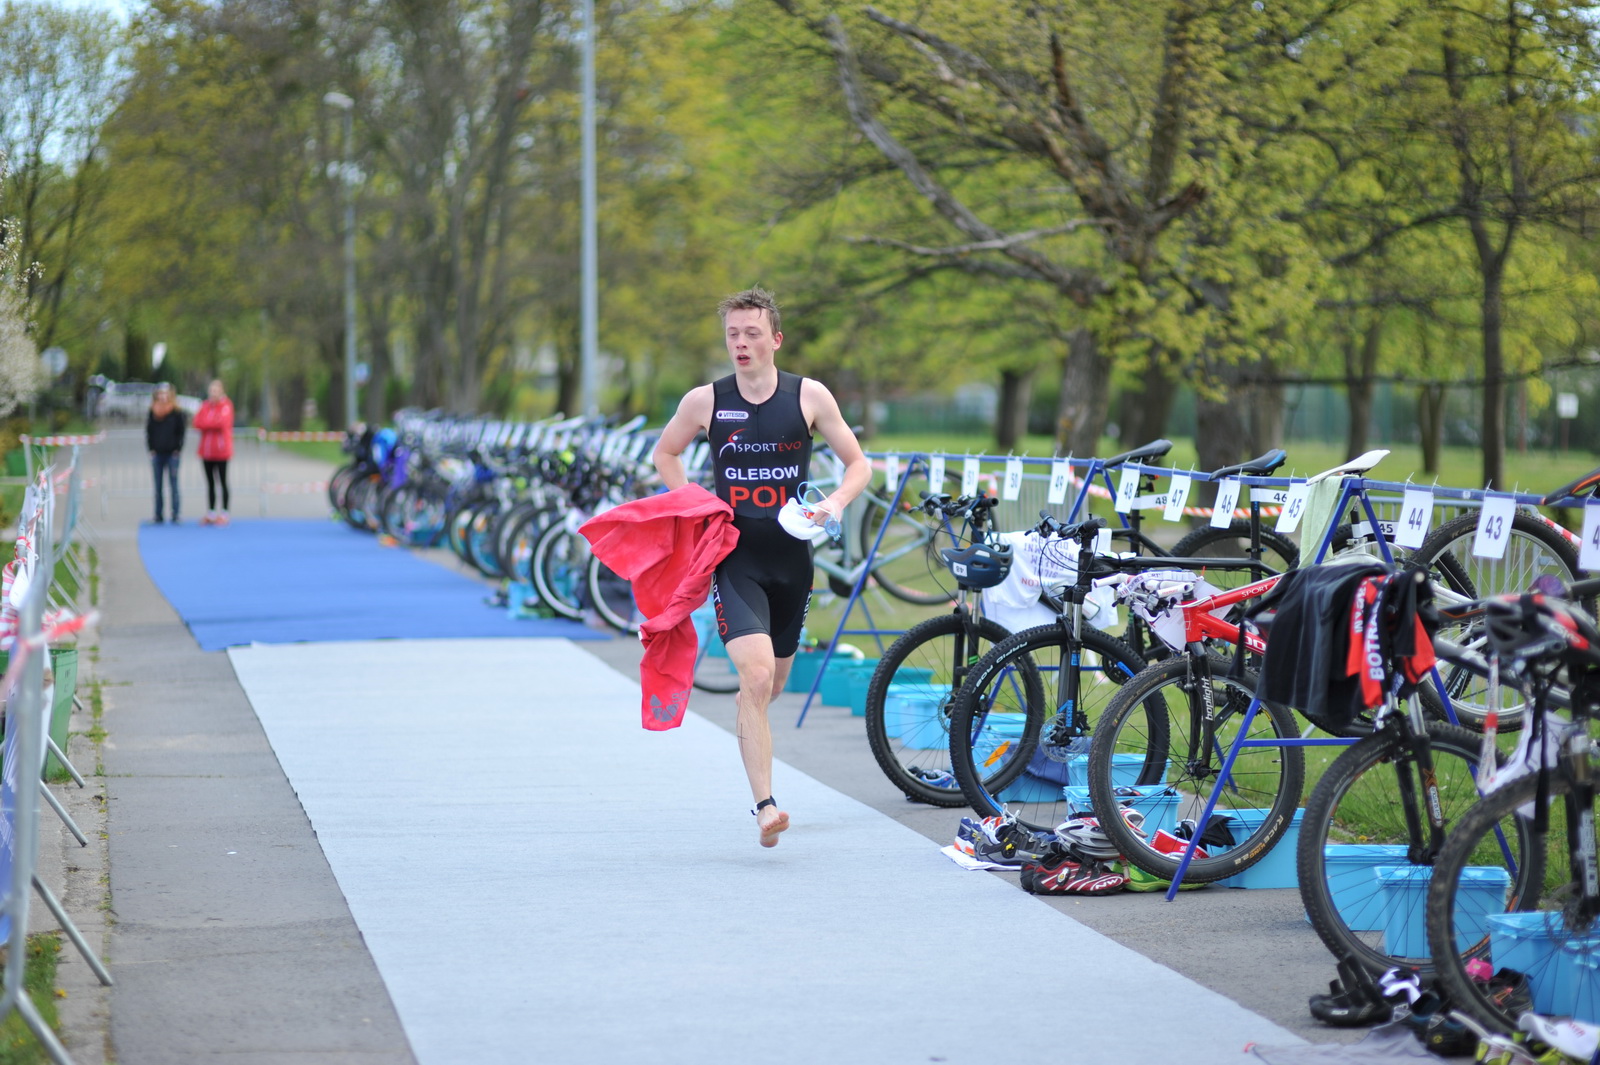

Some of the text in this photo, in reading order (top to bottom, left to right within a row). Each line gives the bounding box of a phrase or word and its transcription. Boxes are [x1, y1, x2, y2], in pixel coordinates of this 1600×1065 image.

[737, 440, 802, 453] SPORTEVO
[725, 465, 799, 480] GLEBOW
[1055, 475, 1064, 492] 49
[1124, 482, 1134, 500] 48
[1171, 489, 1184, 508] 47
[1221, 495, 1232, 514] 46
[1273, 492, 1288, 503] 46
[1288, 498, 1302, 518] 45
[1408, 507, 1424, 531] 44
[1485, 515, 1504, 540] 43
[1379, 523, 1394, 534] 45
[1592, 525, 1600, 550] 4
[1241, 585, 1269, 598] SPORT
[1263, 814, 1285, 844] RACE
[1095, 878, 1119, 890] NW
